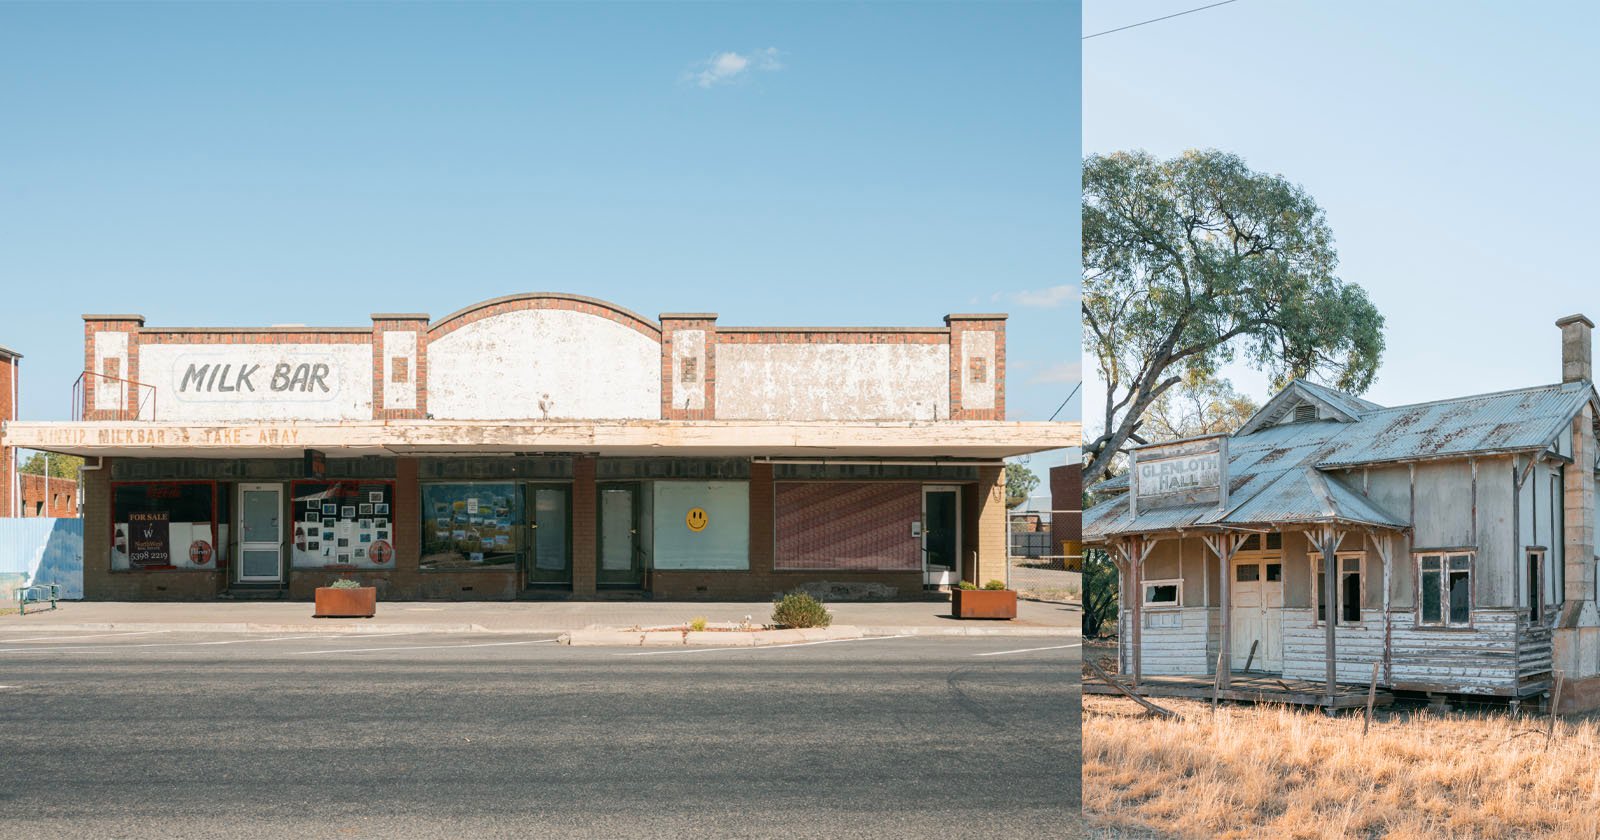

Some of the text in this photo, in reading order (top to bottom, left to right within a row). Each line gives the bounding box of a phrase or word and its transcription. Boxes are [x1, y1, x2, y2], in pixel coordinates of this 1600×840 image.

[179, 363, 330, 393] MILK BAR
[1141, 456, 1218, 478] GLENLOTH
[1160, 473, 1199, 491] HALL
[130, 513, 168, 521] FOR SALE
[131, 551, 168, 561] 5398 2219
